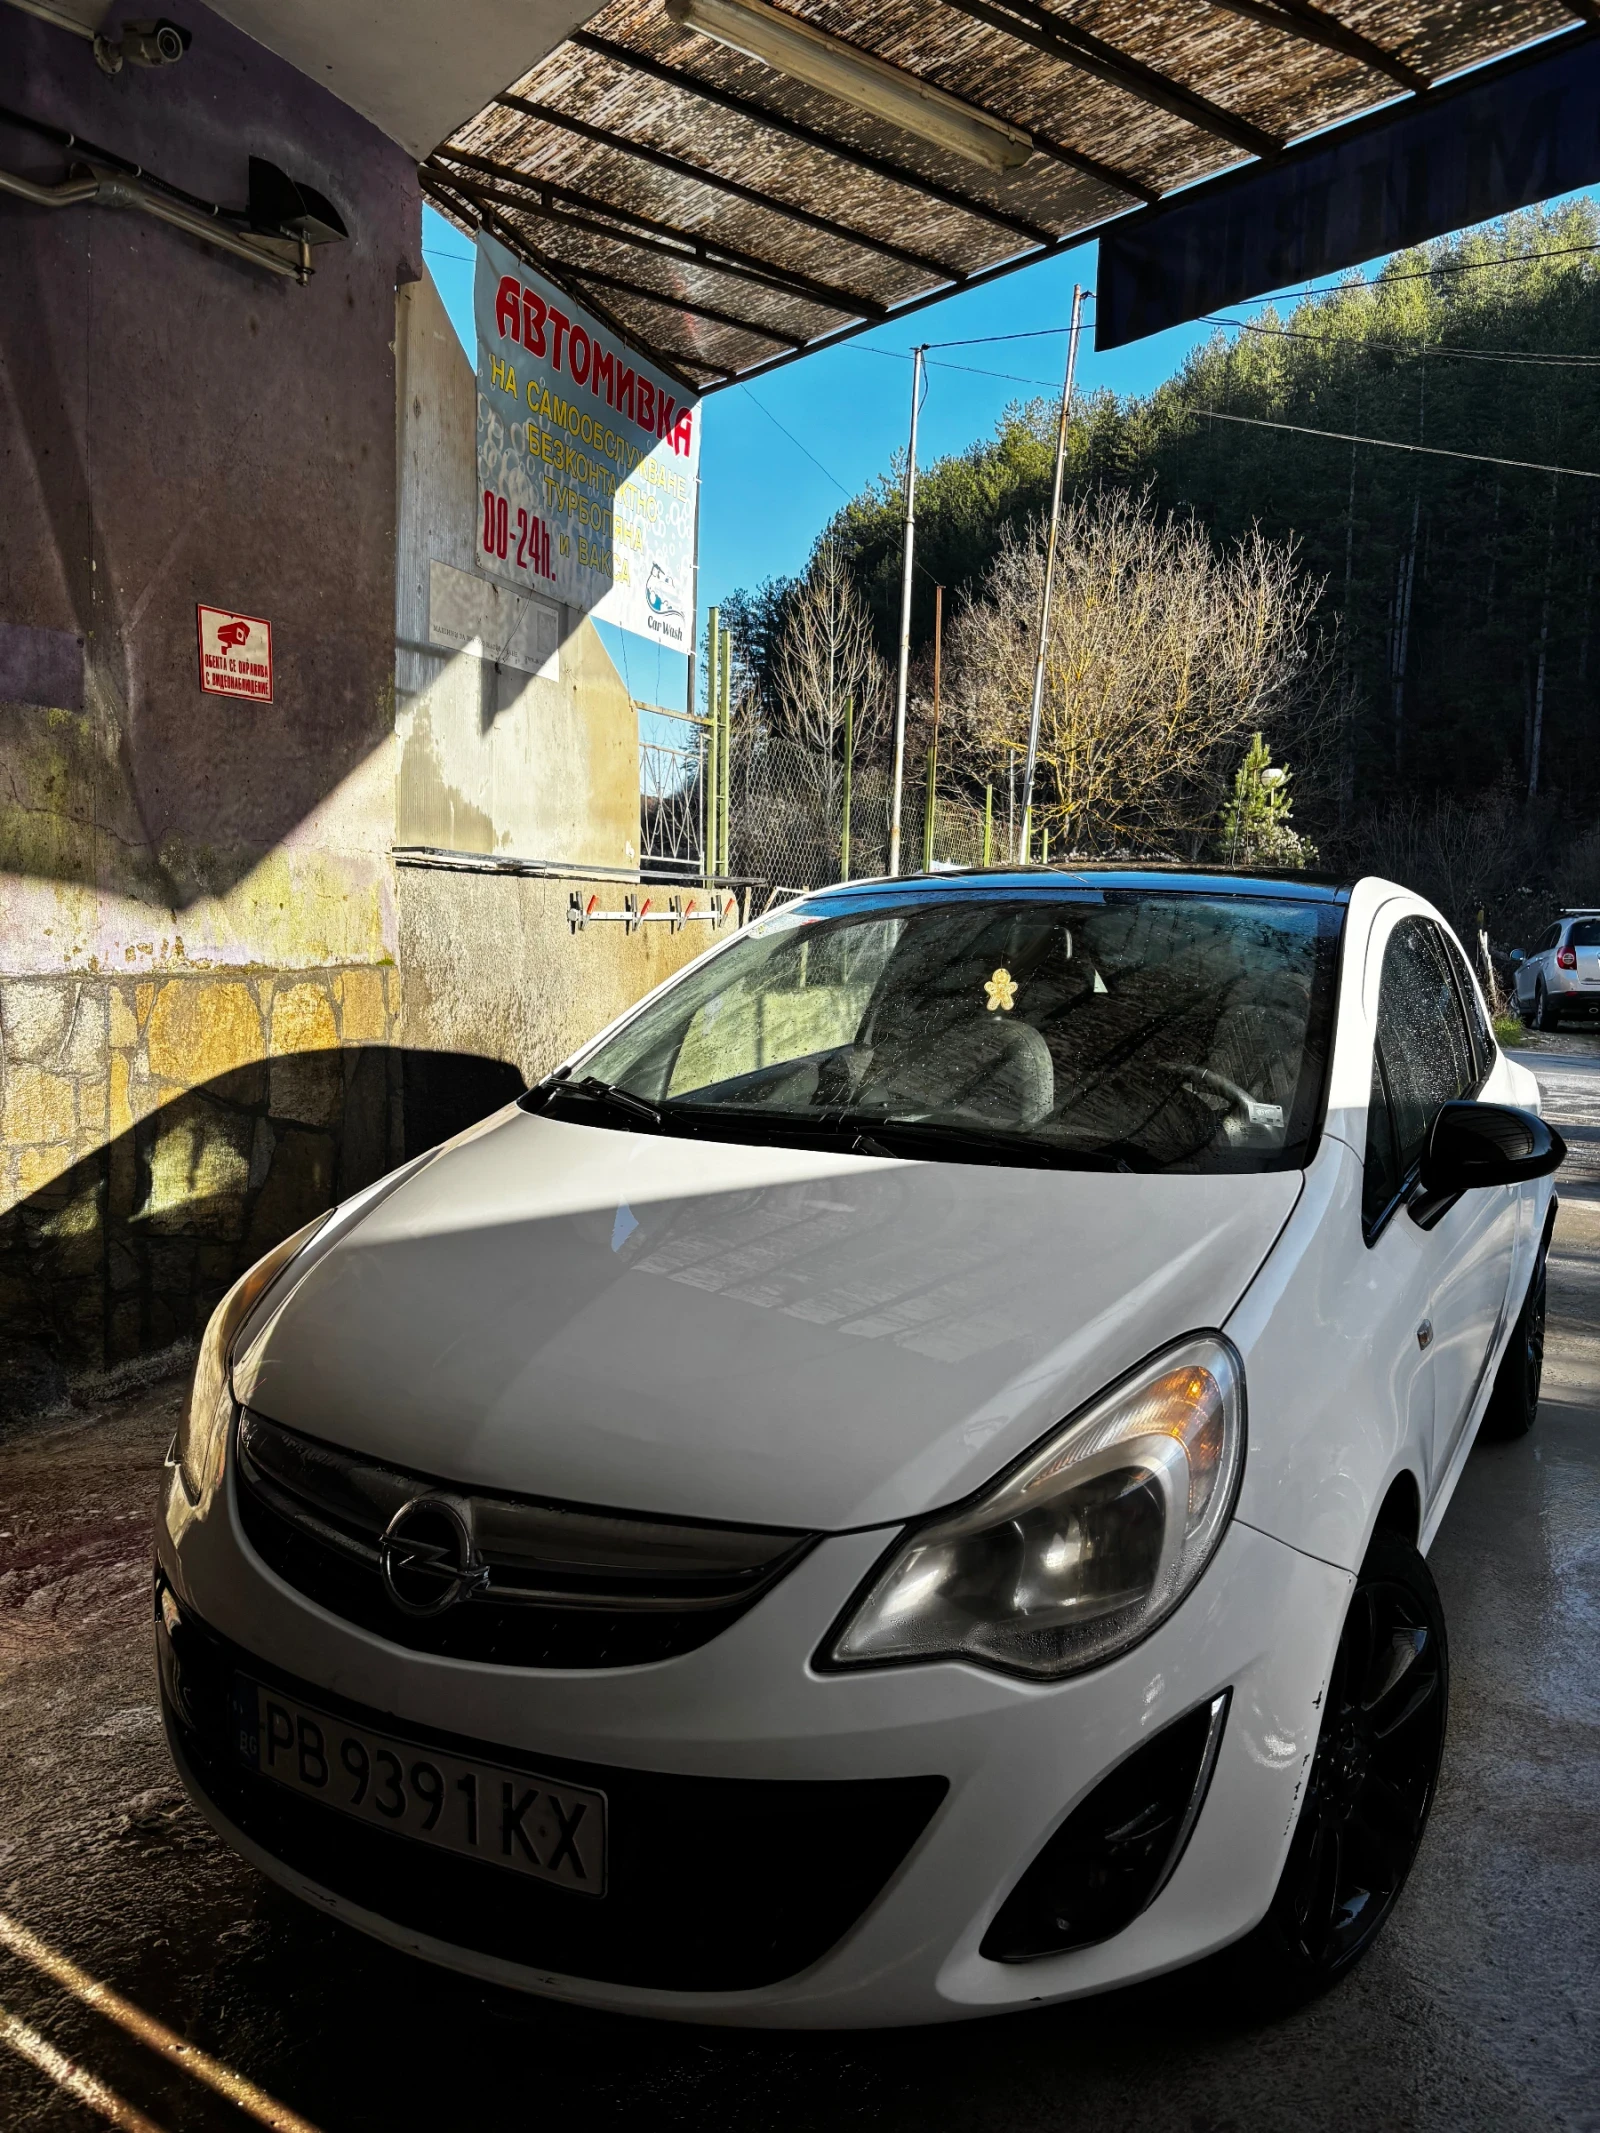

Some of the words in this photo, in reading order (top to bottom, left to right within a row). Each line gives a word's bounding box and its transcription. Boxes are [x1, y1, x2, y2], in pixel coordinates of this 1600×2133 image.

[495, 275, 693, 458] АВТОМИВКА
[491, 354, 518, 400] НА
[527, 380, 687, 501] САМООБСЛУЖВАНЕ
[528, 423, 658, 523] БЕЗКОНТАКТНО
[544, 476, 644, 554] ТУРБОПЯНА
[578, 534, 631, 587] ВАКСА
[204, 654, 227, 671] ОБЕКТА
[229, 658, 237, 673] СЕ
[647, 615, 662, 632] Car
[663, 621, 683, 642] Wash
[205, 671, 210, 685] С
[212, 673, 269, 695] ВИДЕОНАБЛЮДЕНИЕ
[267, 1701, 329, 1788] PB
[340, 1737, 480, 1846] 9391
[502, 1780, 588, 1879] KX
